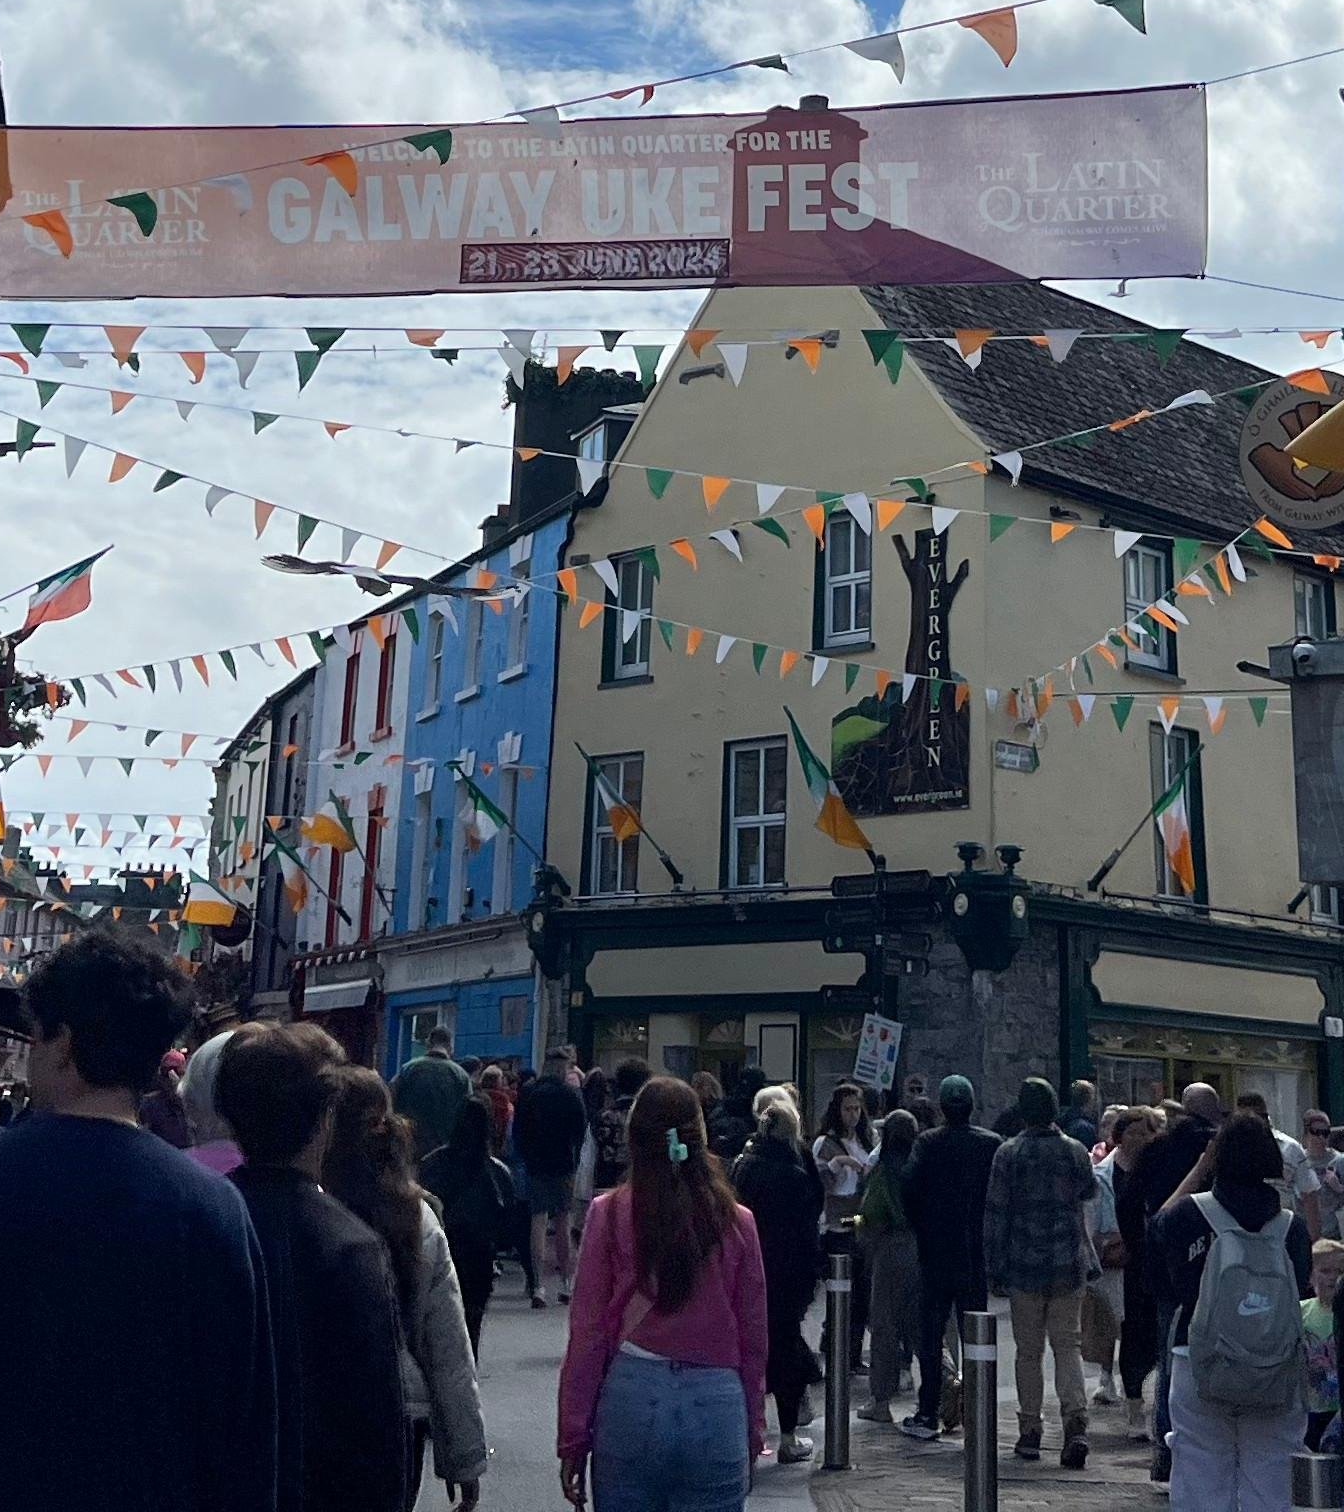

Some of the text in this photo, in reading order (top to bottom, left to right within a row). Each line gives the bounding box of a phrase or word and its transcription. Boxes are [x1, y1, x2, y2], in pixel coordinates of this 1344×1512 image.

[464, 139, 494, 160] TO
[501, 138, 544, 158] THE
[548, 135, 615, 157] LATIN
[621, 133, 729, 157] QUARTER
[735, 131, 780, 152] FOR
[786, 129, 832, 150] THE
[974, 151, 1164, 194] THE LATIN
[64, 179, 202, 218] LAIN
[267, 161, 920, 244] GALWAY UKE FEST
[978, 185, 1174, 233] QUARTER
[468, 251, 499, 276] 21
[524, 250, 561, 276] 23
[568, 248, 641, 275] JUNE
[1284, 507, 1325, 522] GALWAY
